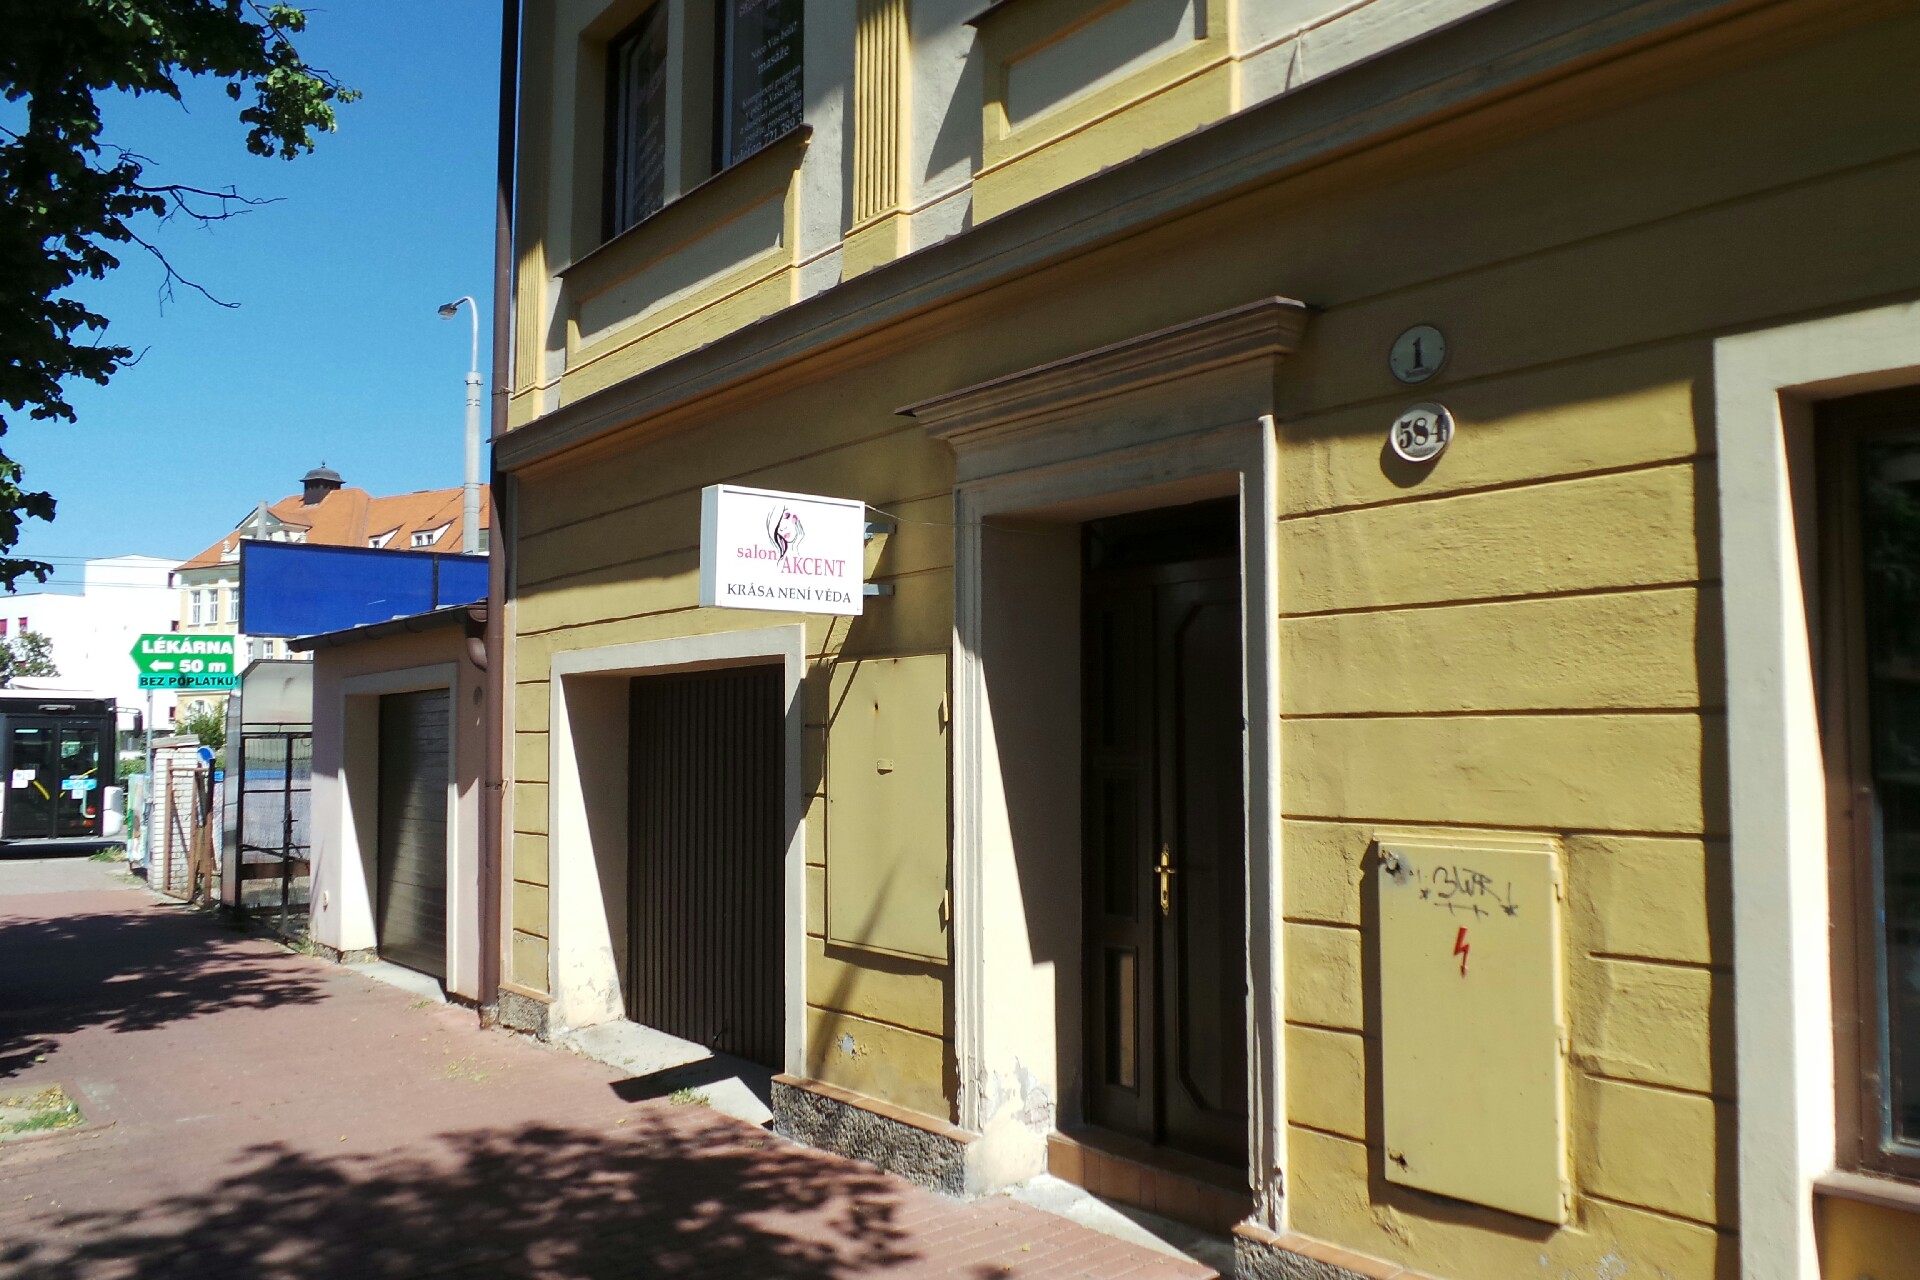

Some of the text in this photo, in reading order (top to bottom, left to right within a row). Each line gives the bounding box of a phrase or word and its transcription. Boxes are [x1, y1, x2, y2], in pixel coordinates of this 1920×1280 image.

[1412, 336, 1424, 369] 1
[1399, 414, 1450, 449] 584
[737, 544, 778, 561] salon
[780, 556, 846, 577] AKCENT
[726, 583, 852, 604] KRÁSA NENÍ VĚDA
[142, 636, 233, 654] LÉKÁRNA
[179, 659, 227, 673] 50 m
[140, 677, 165, 686] BEZ
